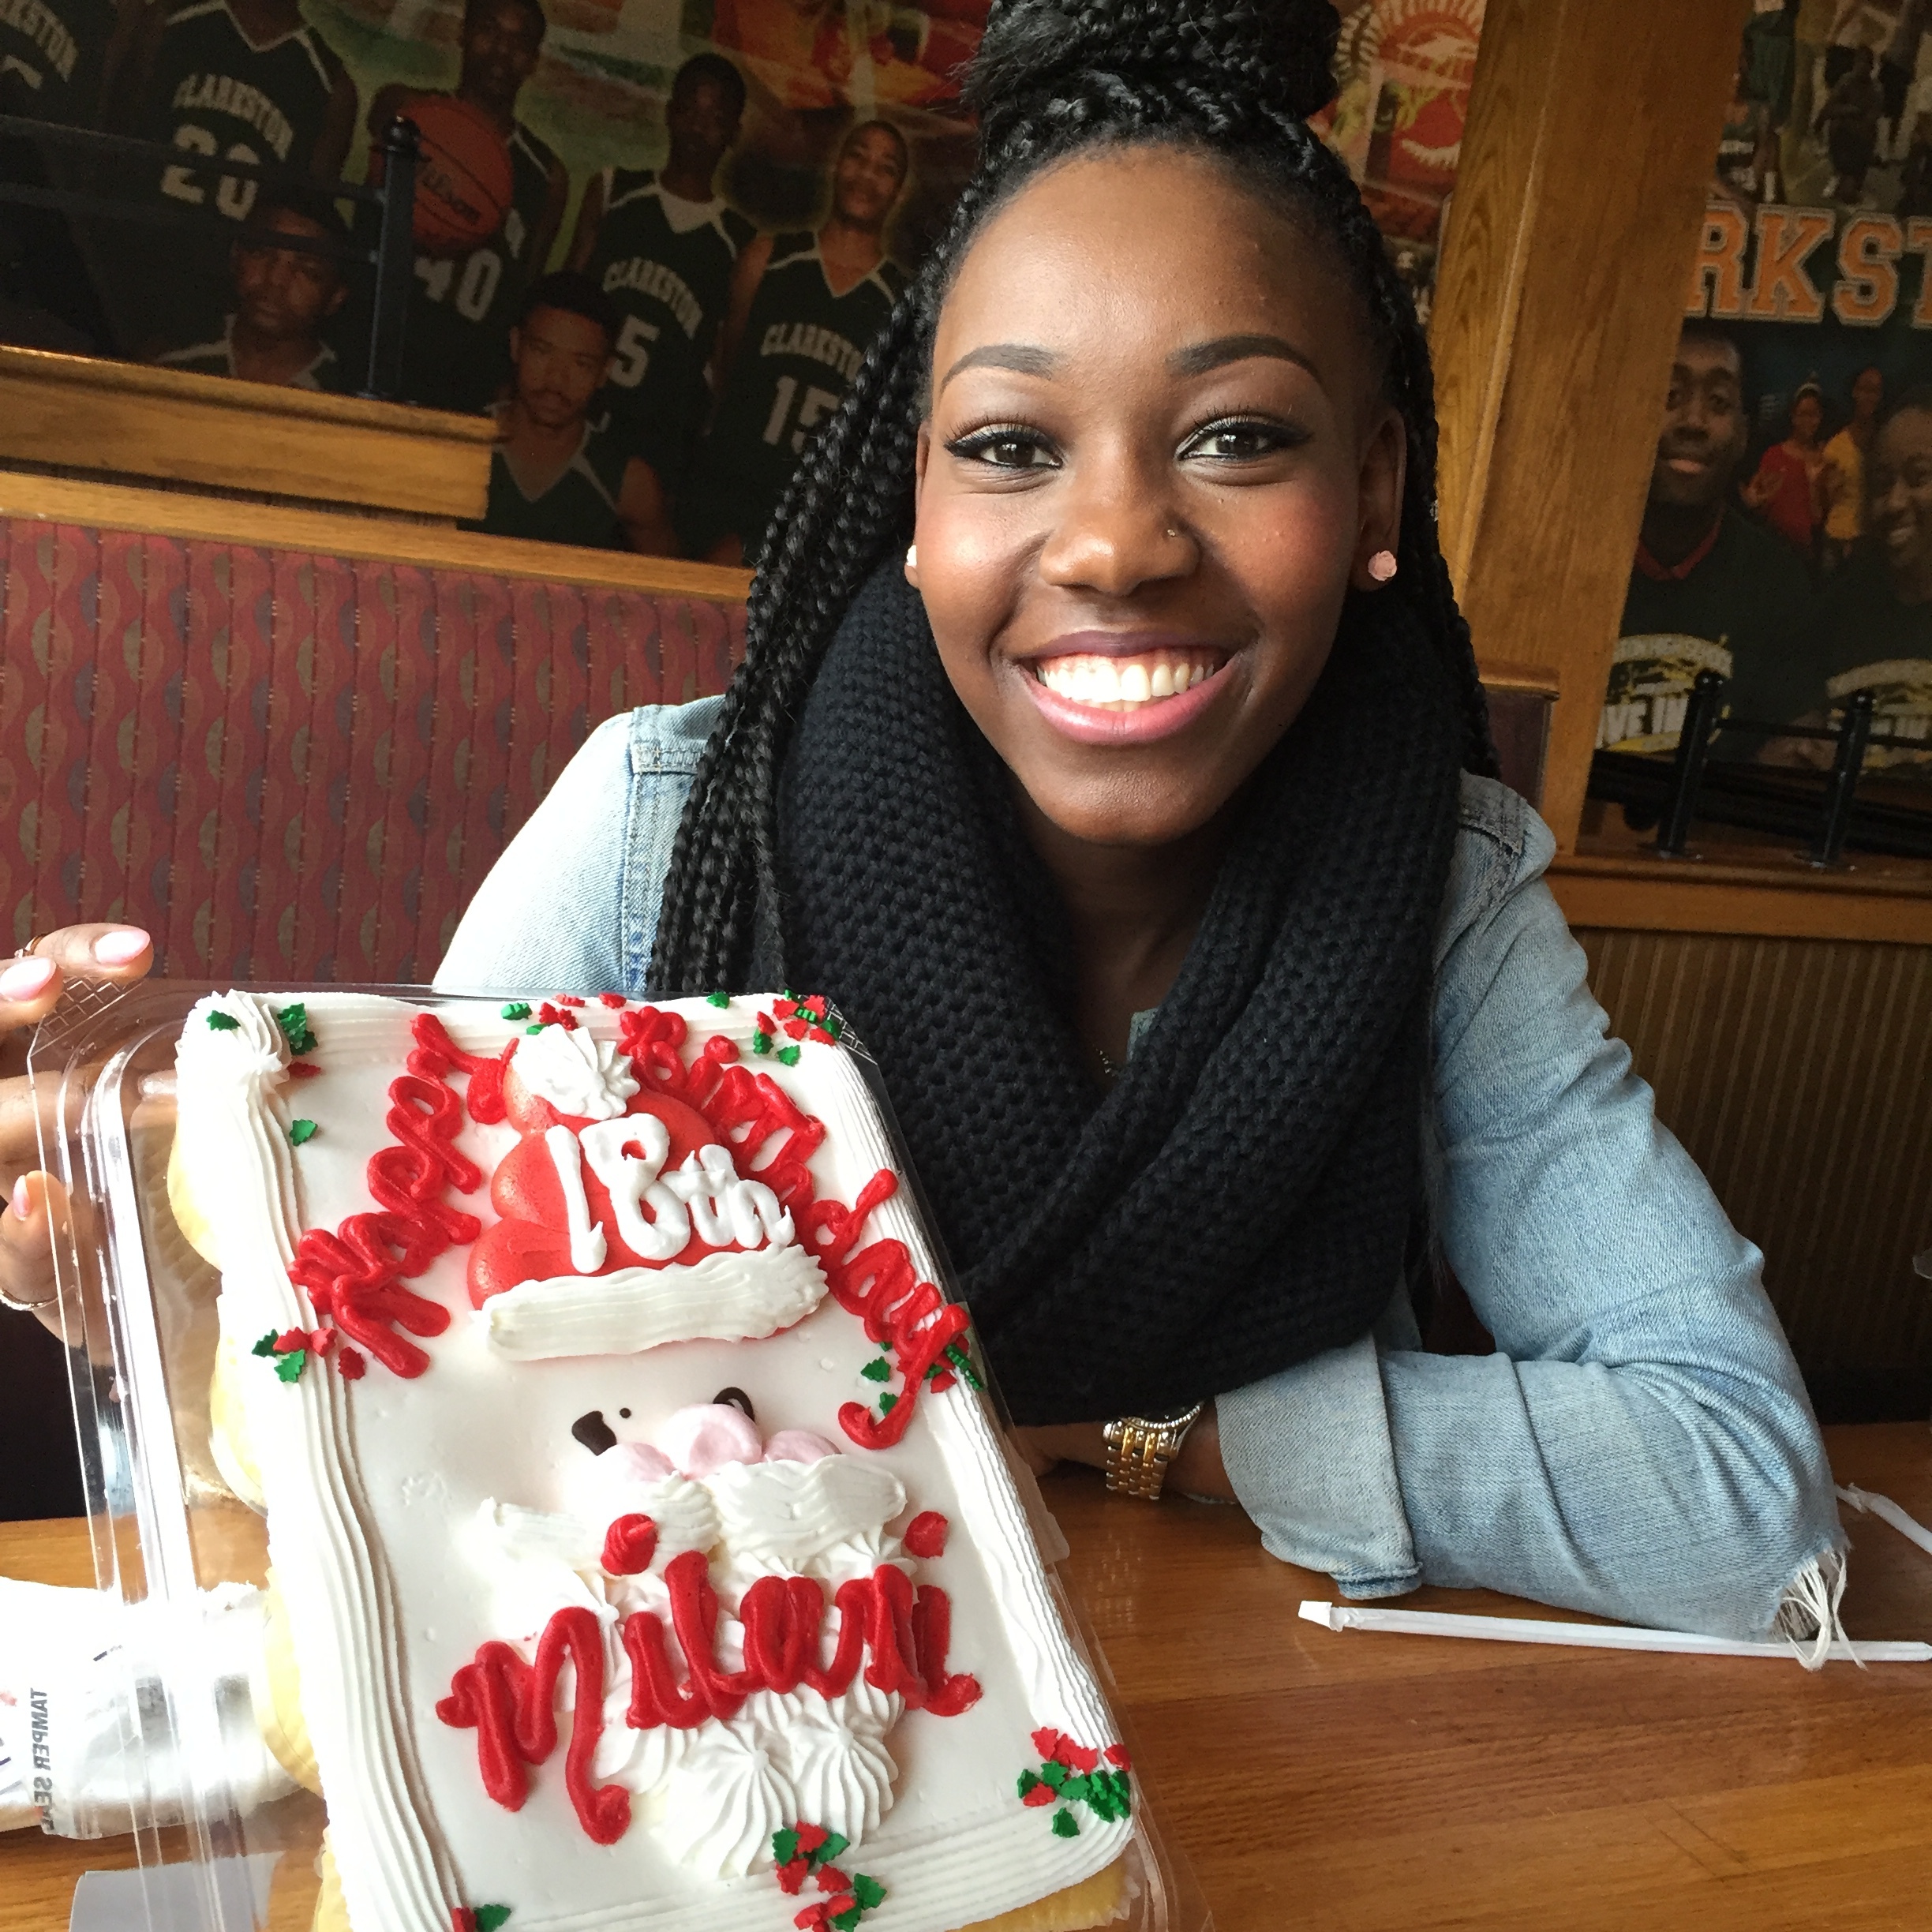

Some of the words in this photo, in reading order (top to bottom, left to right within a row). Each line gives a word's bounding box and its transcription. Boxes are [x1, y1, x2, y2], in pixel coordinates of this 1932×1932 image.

[601, 256, 704, 340] CLARKSTON
[760, 323, 866, 387] CLARKSTO
[287, 1013, 521, 1380] Happy
[618, 1005, 971, 1451] Birthday
[545, 1112, 796, 1275] 18th
